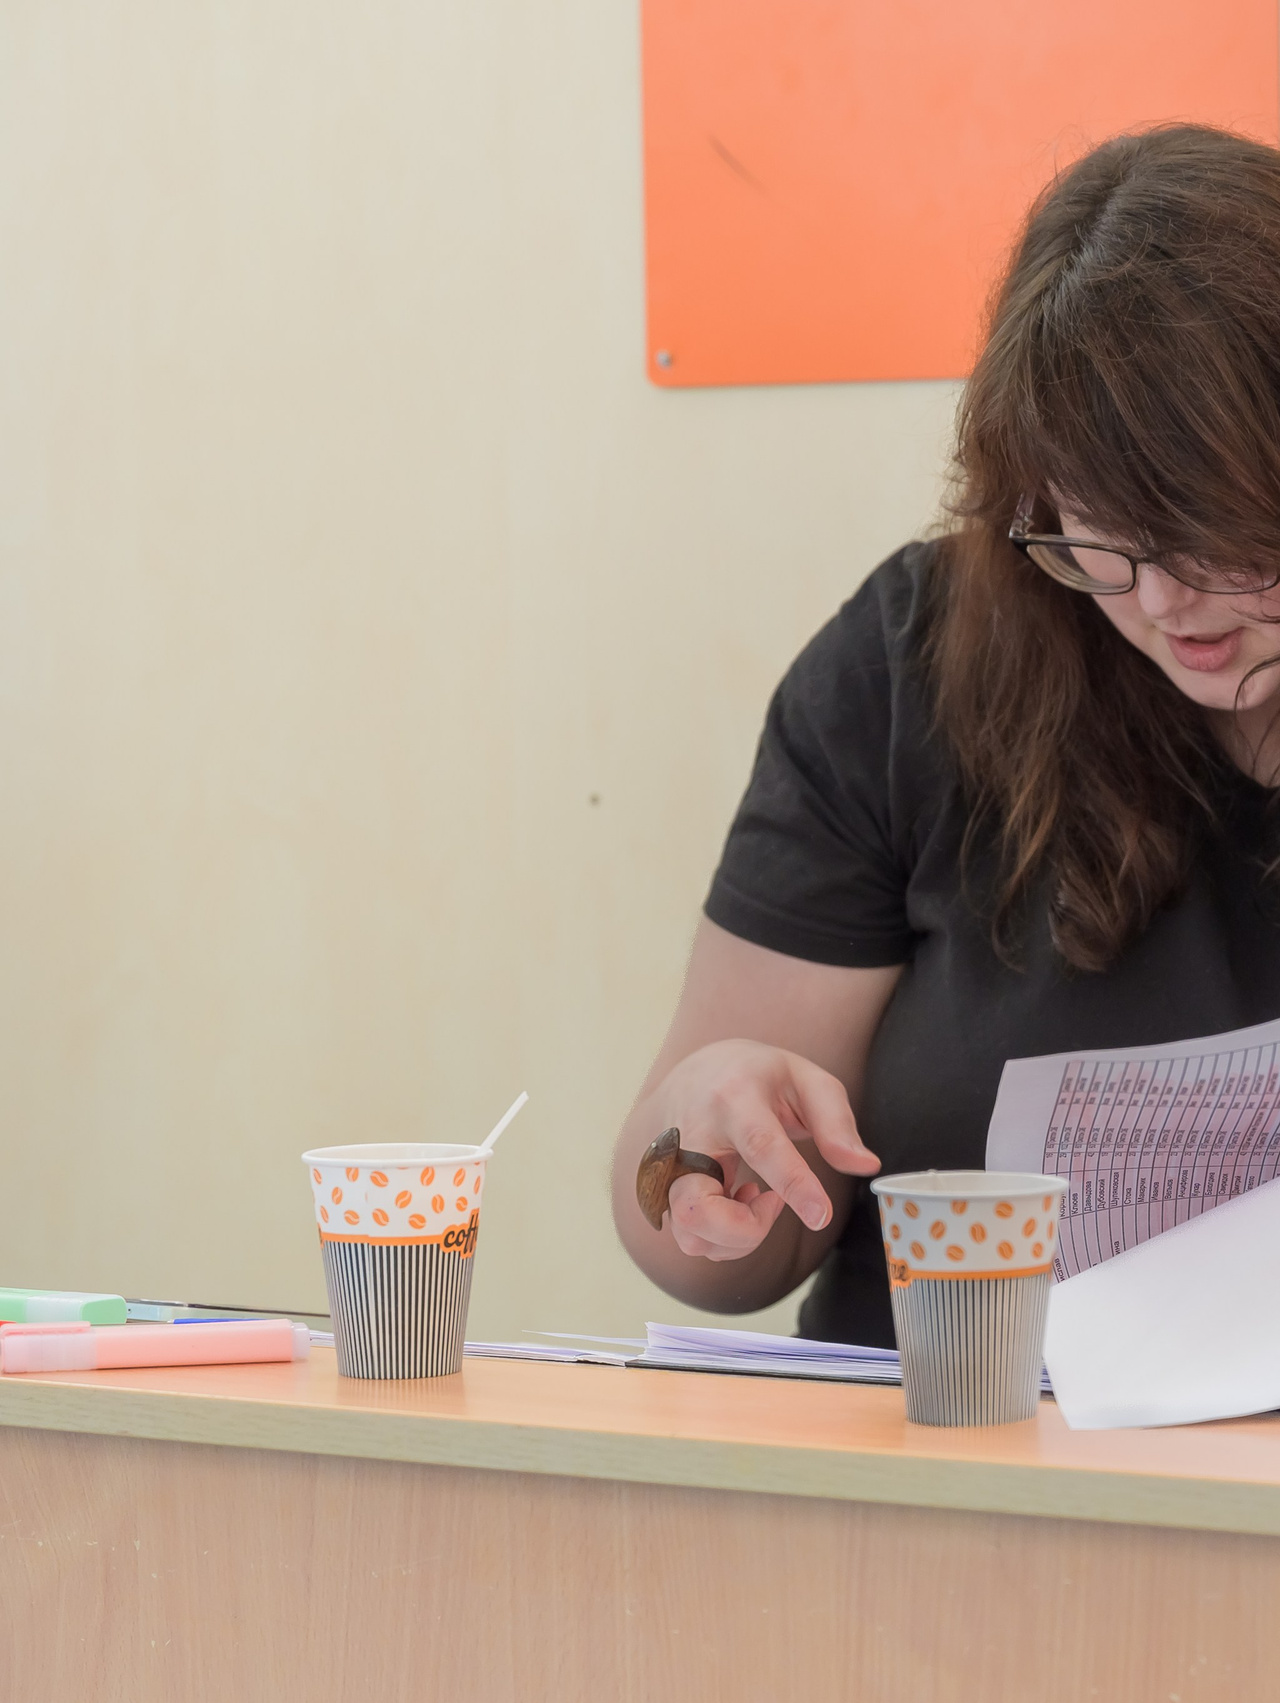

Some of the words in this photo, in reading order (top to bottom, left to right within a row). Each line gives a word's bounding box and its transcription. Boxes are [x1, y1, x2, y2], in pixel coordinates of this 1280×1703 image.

[1071, 1192, 1079, 1215] Клюев
[1084, 1181, 1092, 1212] Давыдова
[443, 1212, 479, 1255] coff
[1054, 1257, 1066, 1282] ислав
